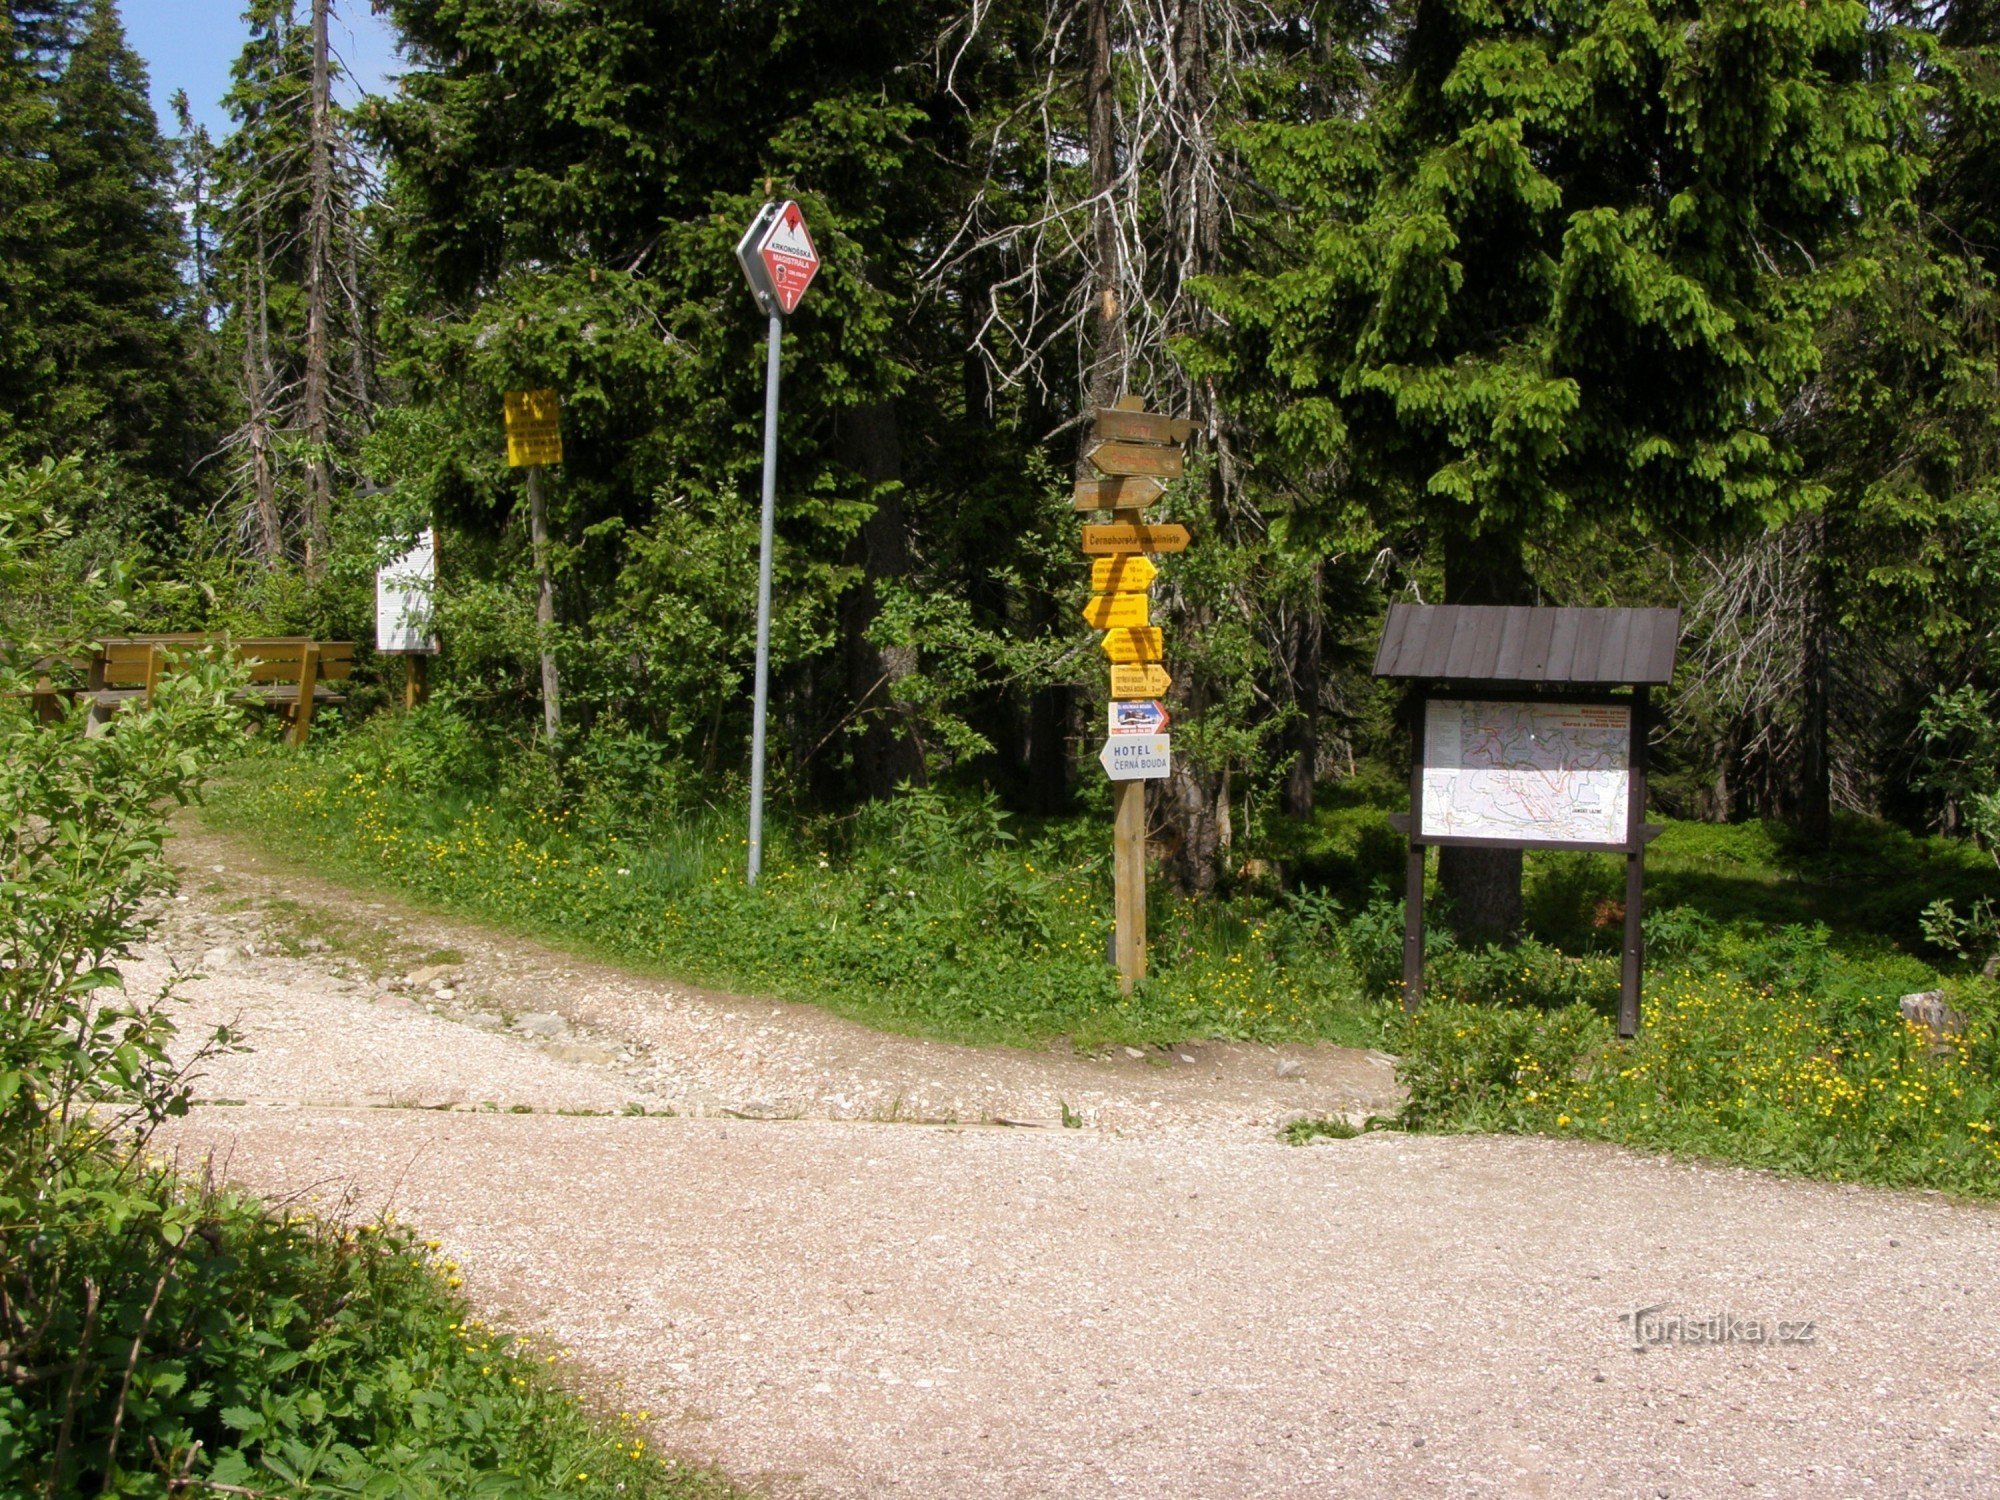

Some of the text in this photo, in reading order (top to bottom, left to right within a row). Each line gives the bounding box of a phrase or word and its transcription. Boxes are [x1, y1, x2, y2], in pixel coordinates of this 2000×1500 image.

[1114, 745, 1151, 756] HOTEL
[1114, 758, 1167, 770] ČERNÁ BOUDA
